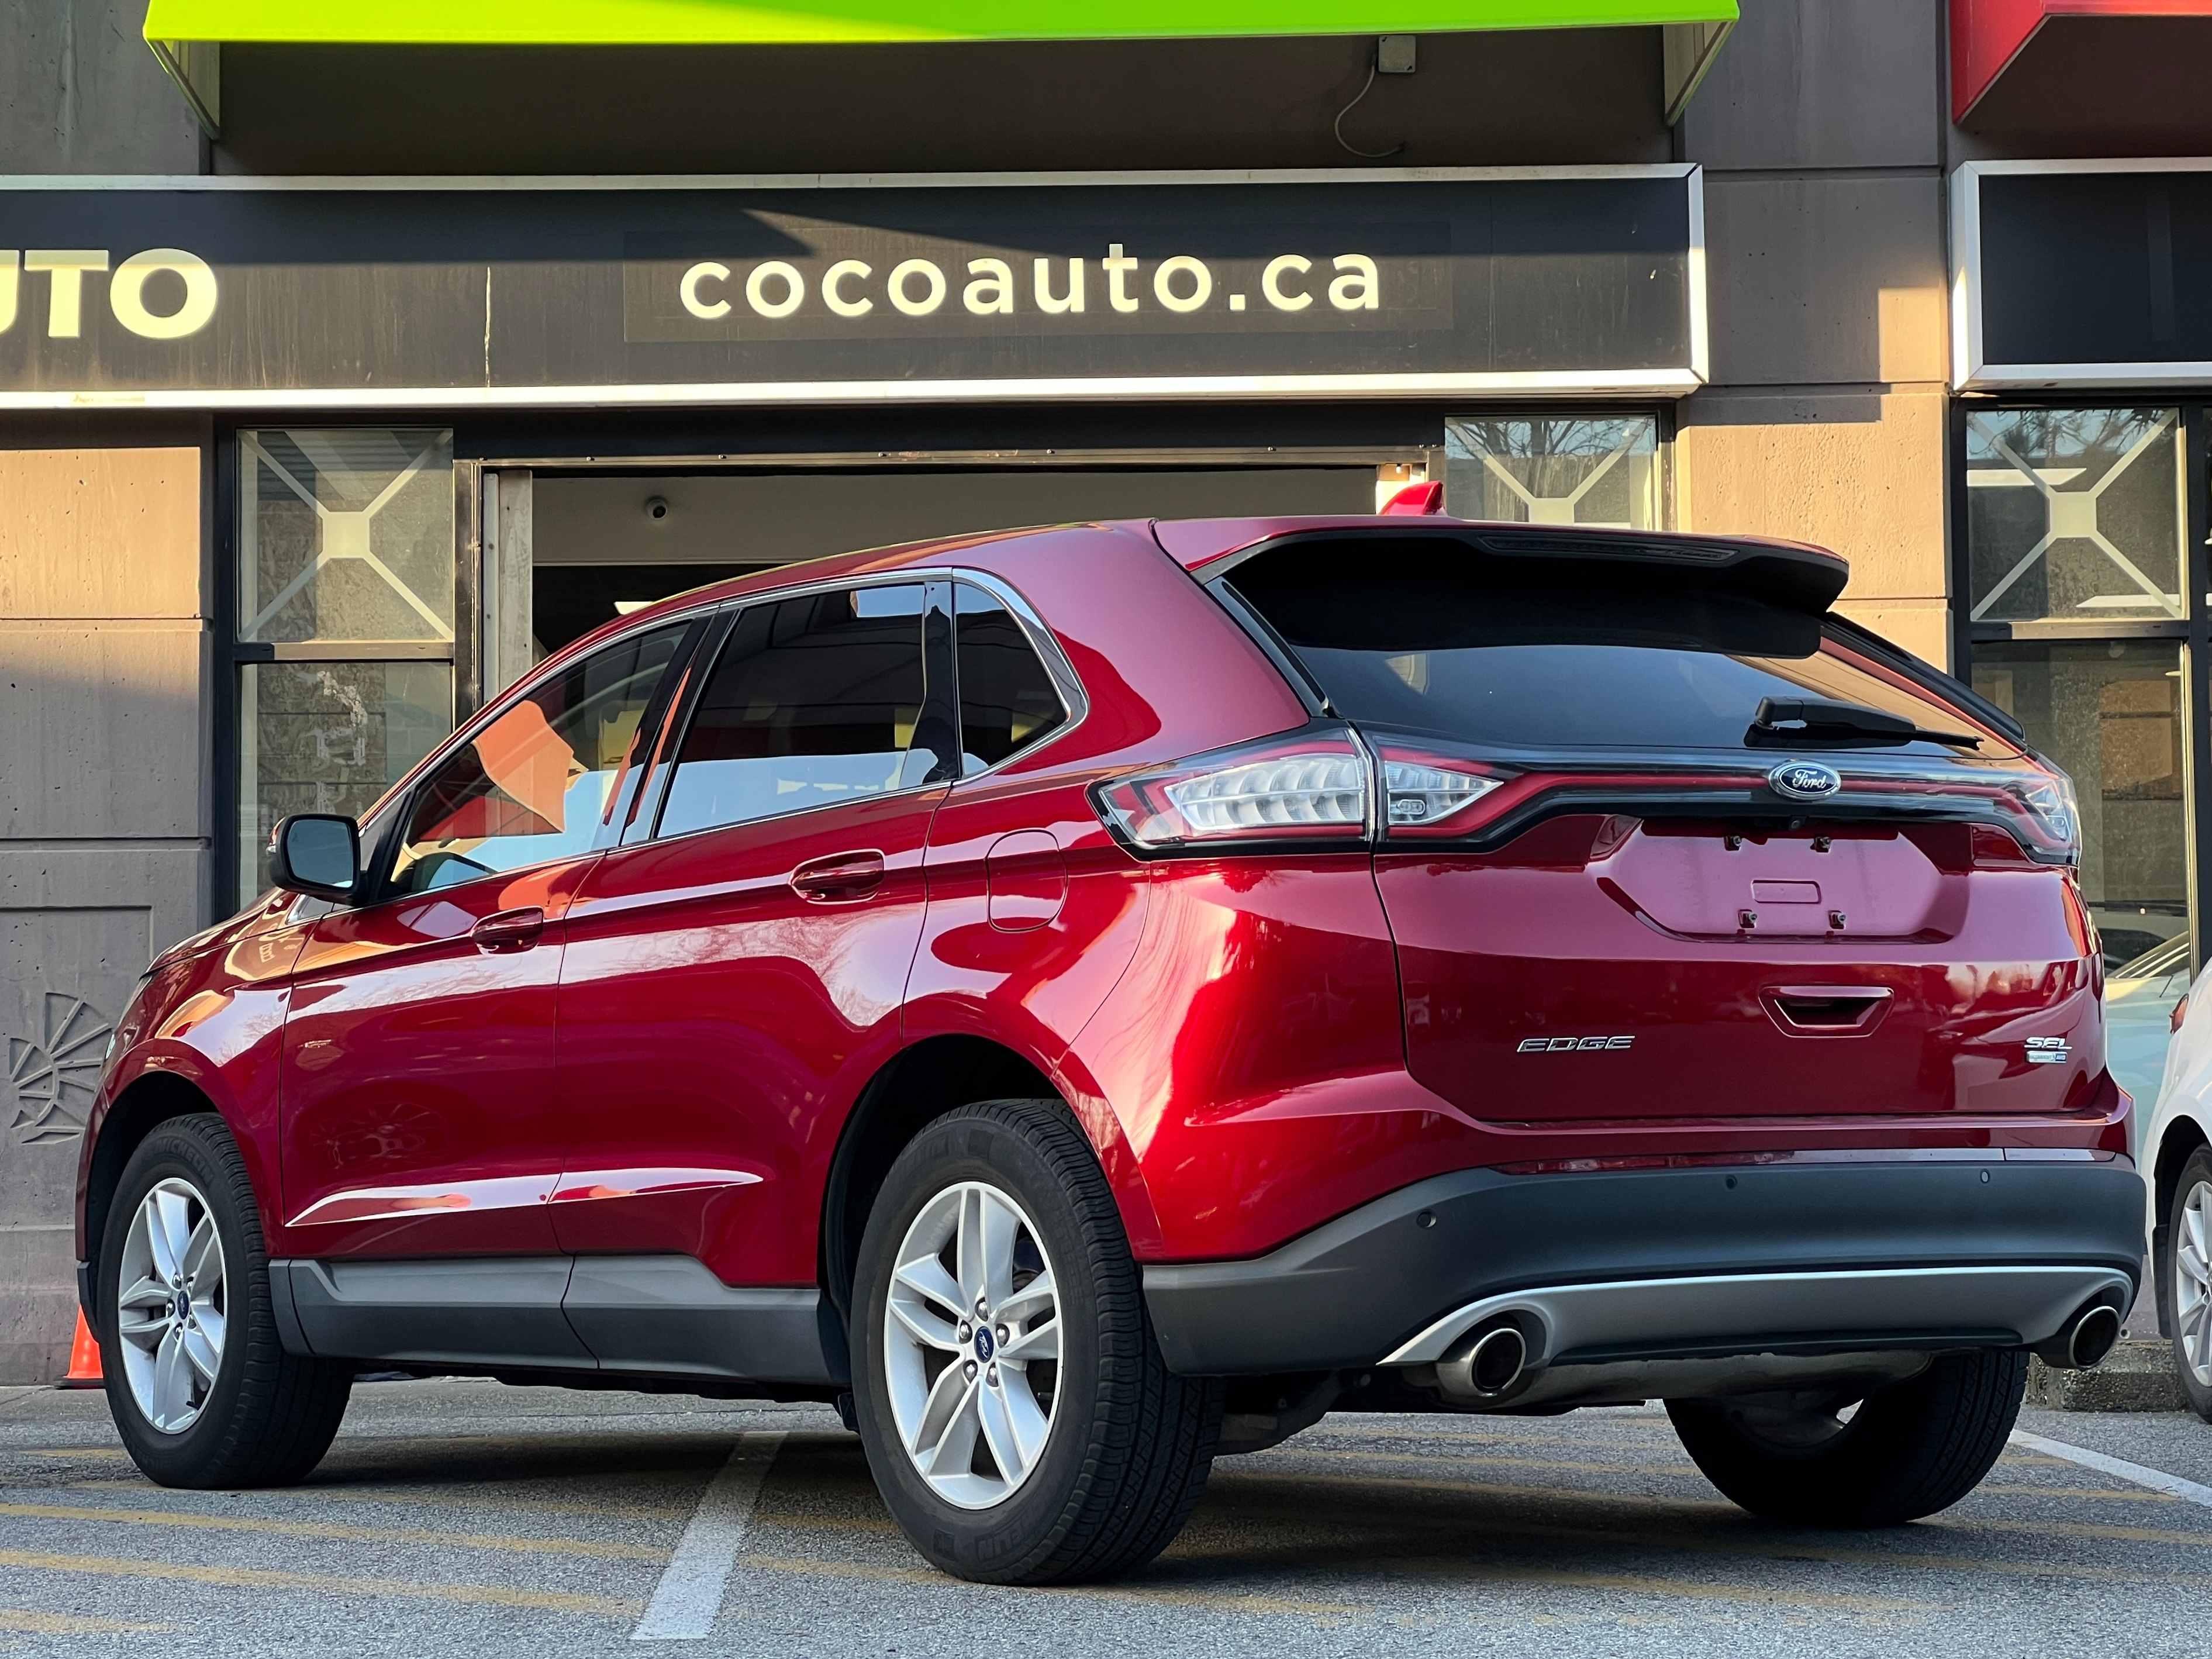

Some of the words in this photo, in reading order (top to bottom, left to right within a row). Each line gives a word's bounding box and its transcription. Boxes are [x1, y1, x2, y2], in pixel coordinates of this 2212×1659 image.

[679, 243, 1381, 320] cocoauto.ca
[0, 248, 218, 339] TO
[1792, 769, 1827, 789] Ford
[1517, 1036, 1635, 1052] EDGE
[2024, 1037, 2073, 1050] SEL
